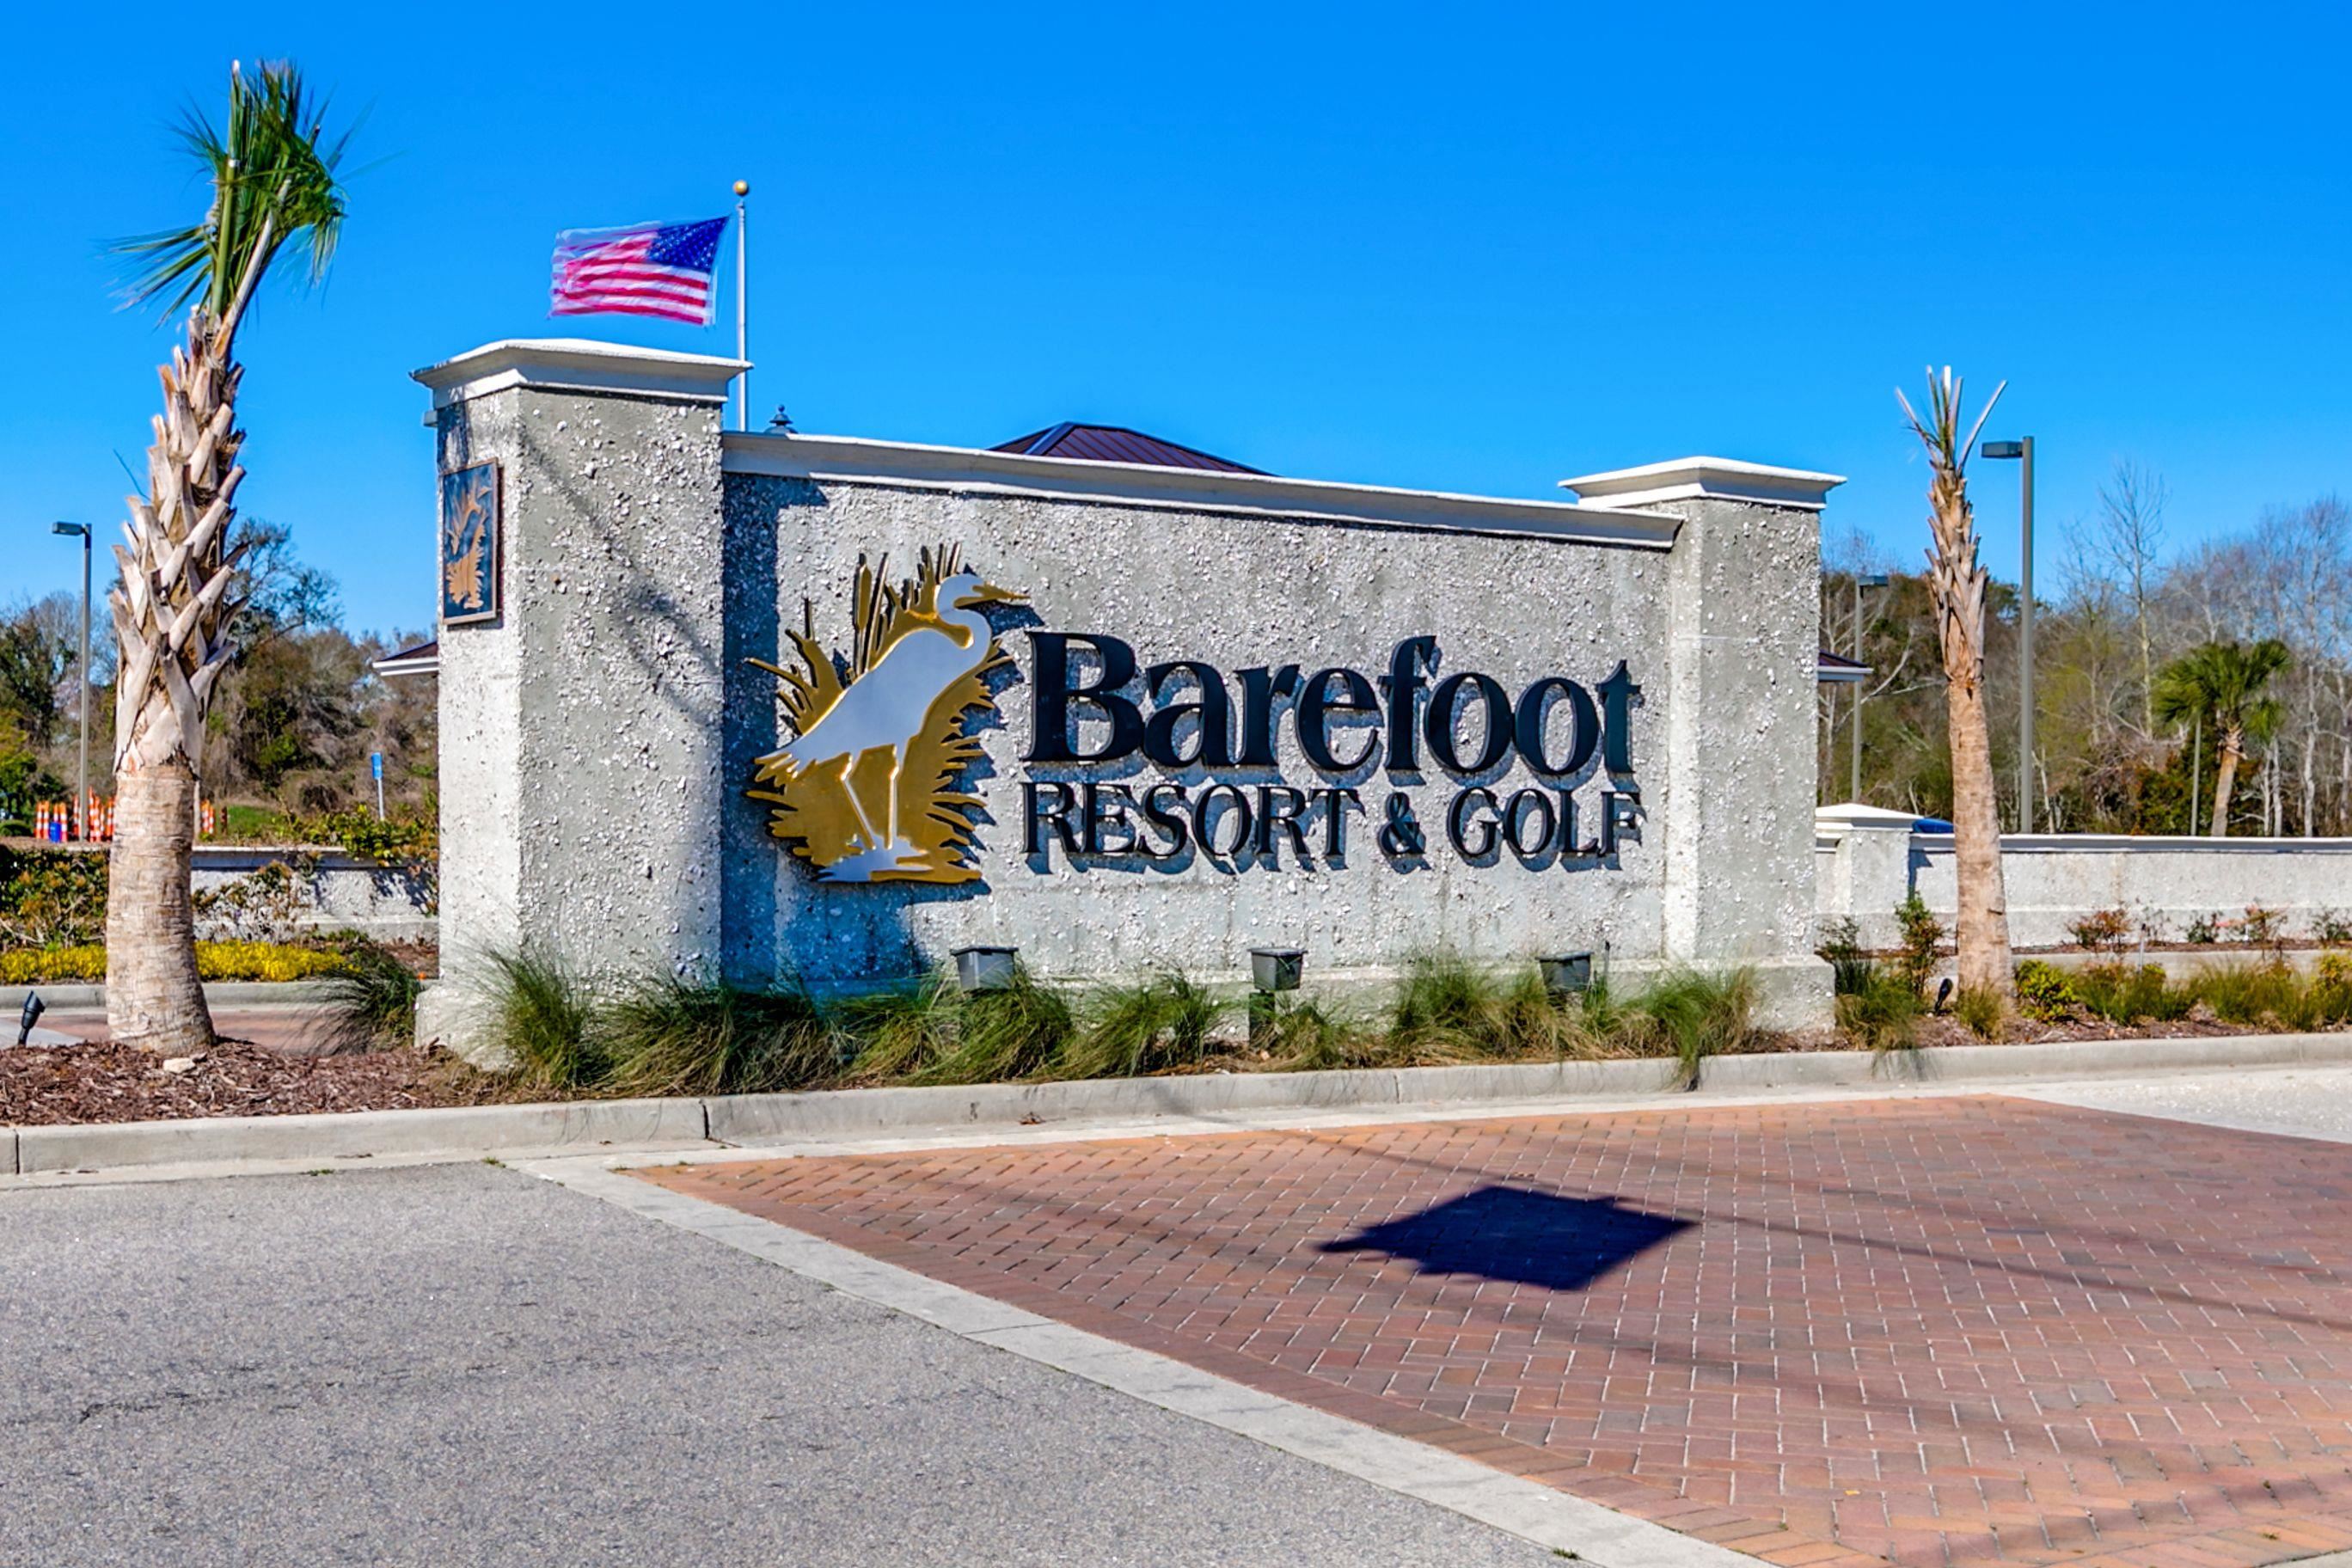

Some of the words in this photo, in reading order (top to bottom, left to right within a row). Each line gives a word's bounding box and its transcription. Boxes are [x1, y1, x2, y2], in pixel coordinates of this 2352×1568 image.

[1022, 631, 1641, 775] Barefoot
[1021, 781, 1359, 856] RESORT
[1378, 792, 1425, 854] &
[1449, 788, 1641, 855] GOLF
